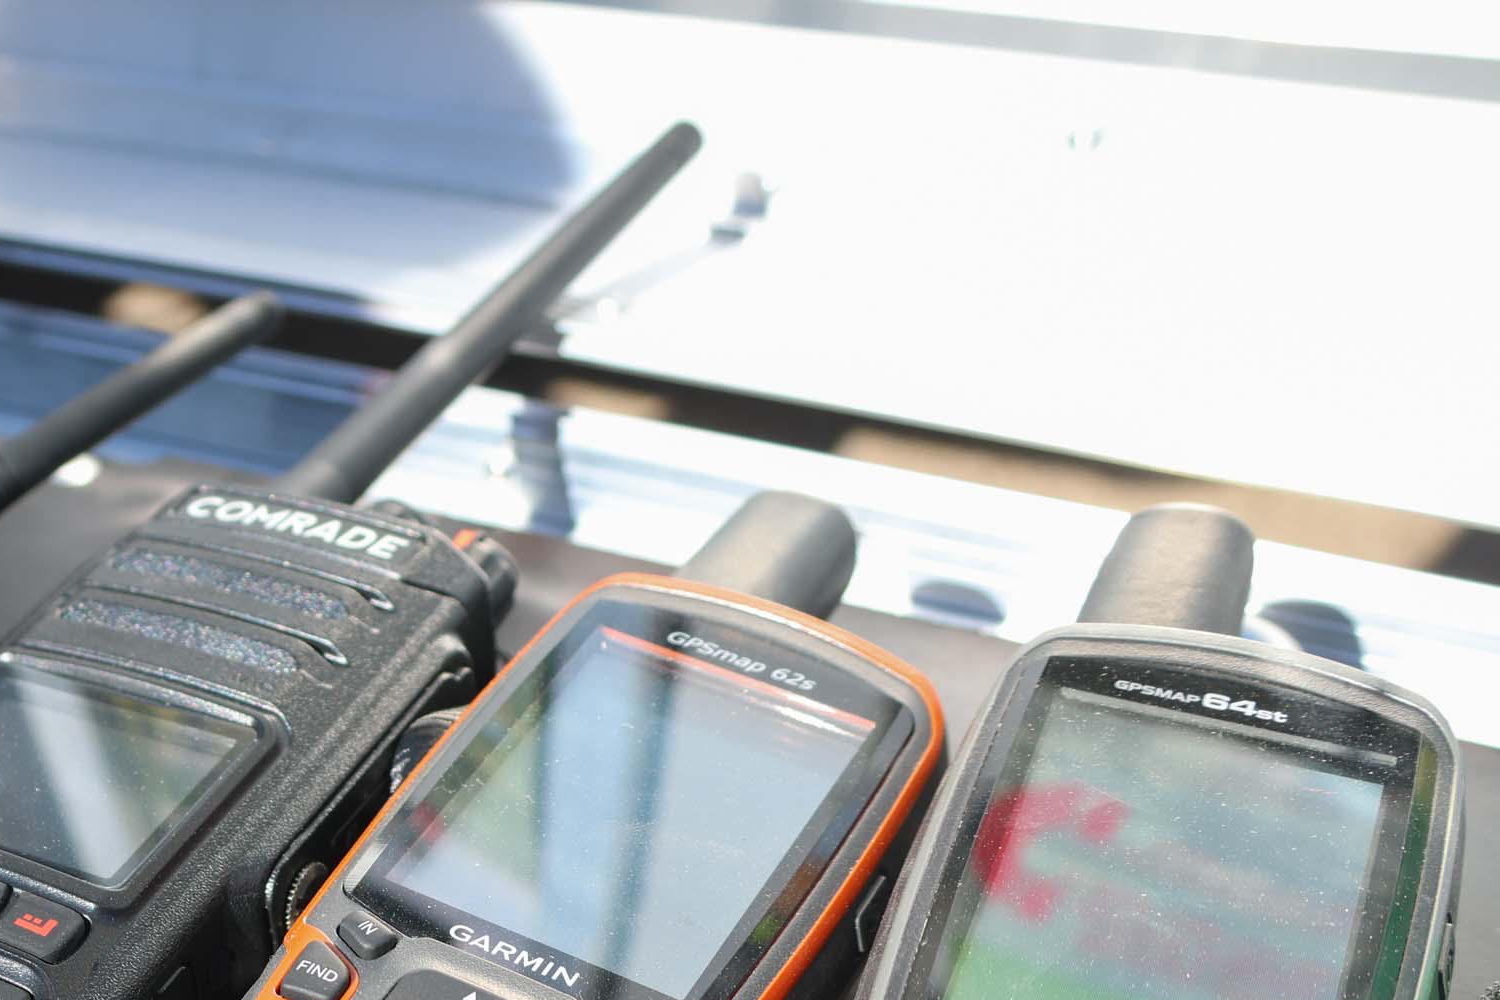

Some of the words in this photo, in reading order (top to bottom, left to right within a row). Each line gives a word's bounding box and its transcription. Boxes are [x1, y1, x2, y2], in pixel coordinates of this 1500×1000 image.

[187, 496, 411, 560] COMRADE
[666, 631, 766, 673] GPSmap
[770, 668, 817, 691] 62s
[358, 919, 376, 936] IN
[448, 924, 581, 987] GARMIN
[296, 959, 339, 983] FIND
